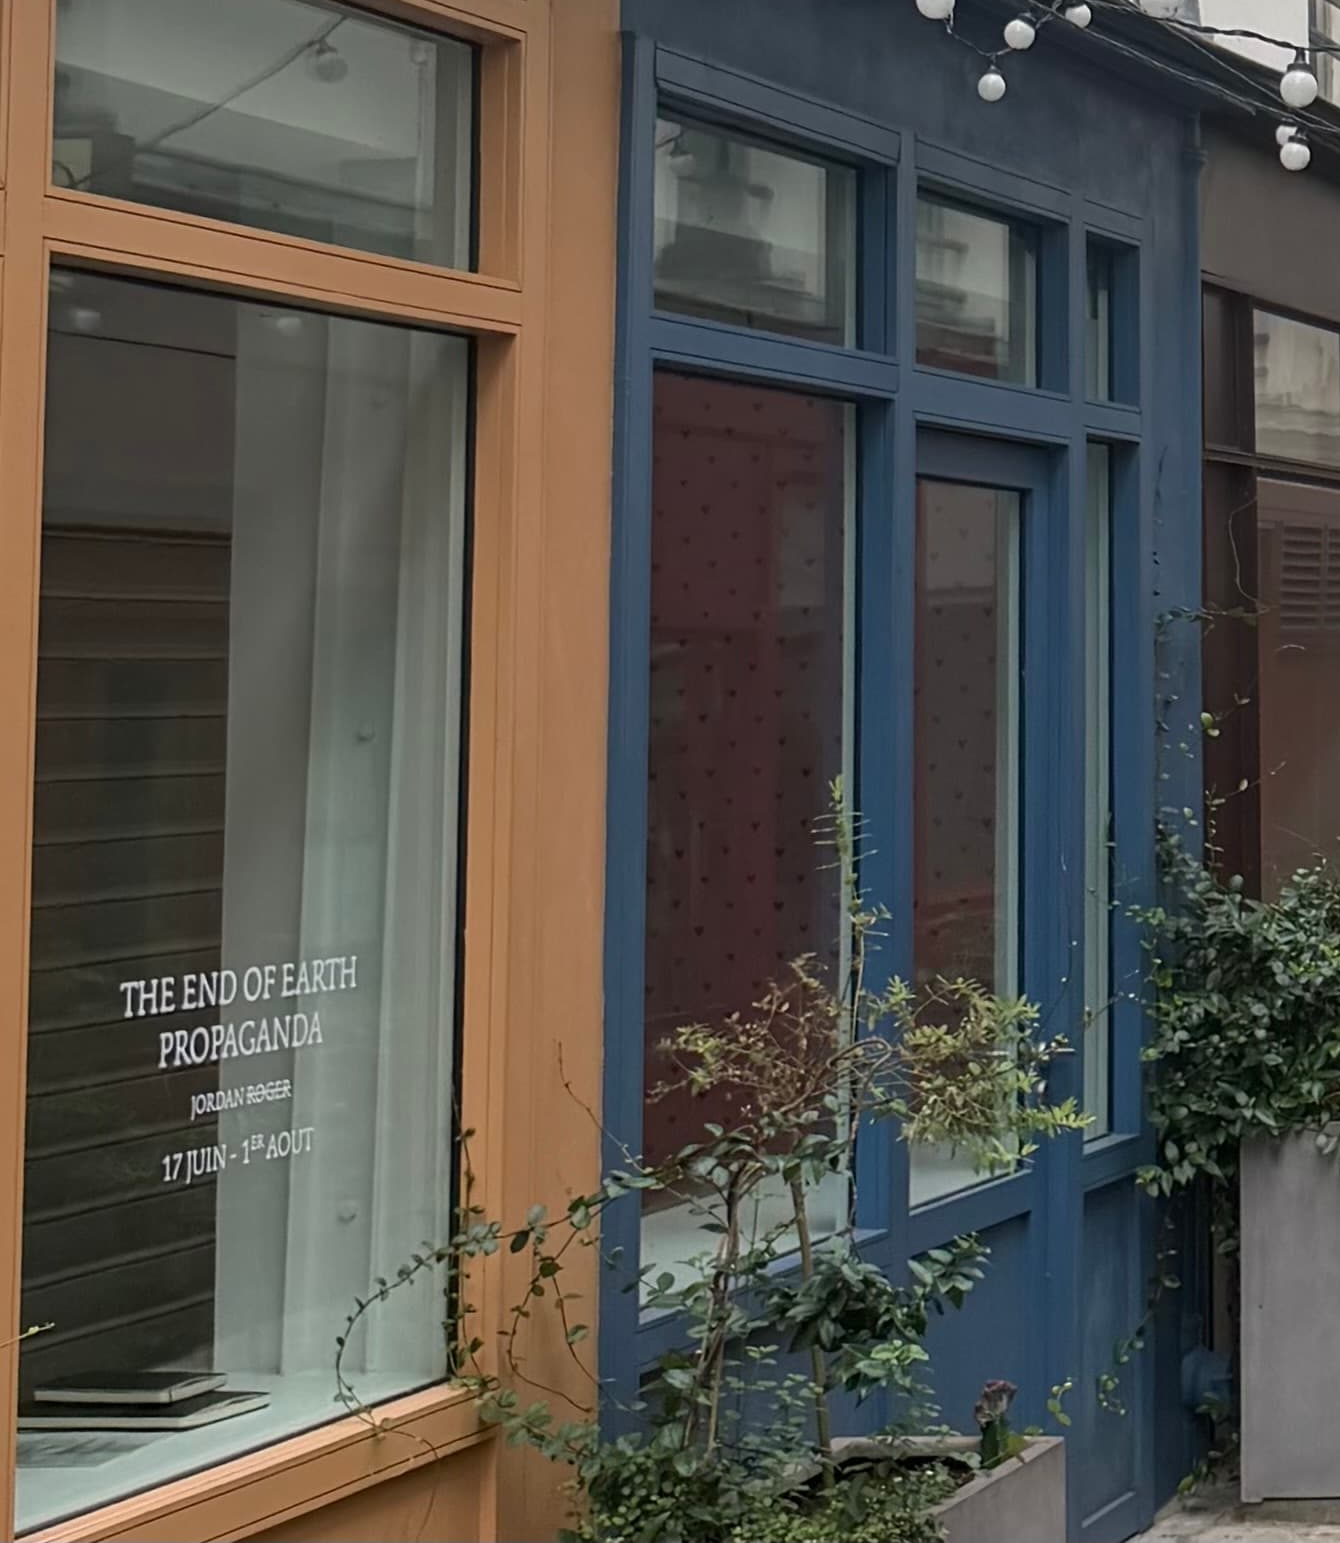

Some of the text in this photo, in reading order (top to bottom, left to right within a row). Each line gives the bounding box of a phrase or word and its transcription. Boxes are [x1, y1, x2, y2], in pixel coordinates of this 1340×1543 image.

[120, 955, 358, 1018] THE END OF EARTH
[158, 1011, 323, 1069] PROPAGANDA
[190, 1086, 245, 1121] JORDAN
[162, 1153, 184, 1182] 17
[185, 1144, 227, 1184] JUIN
[266, 1127, 315, 1160] AOUT
